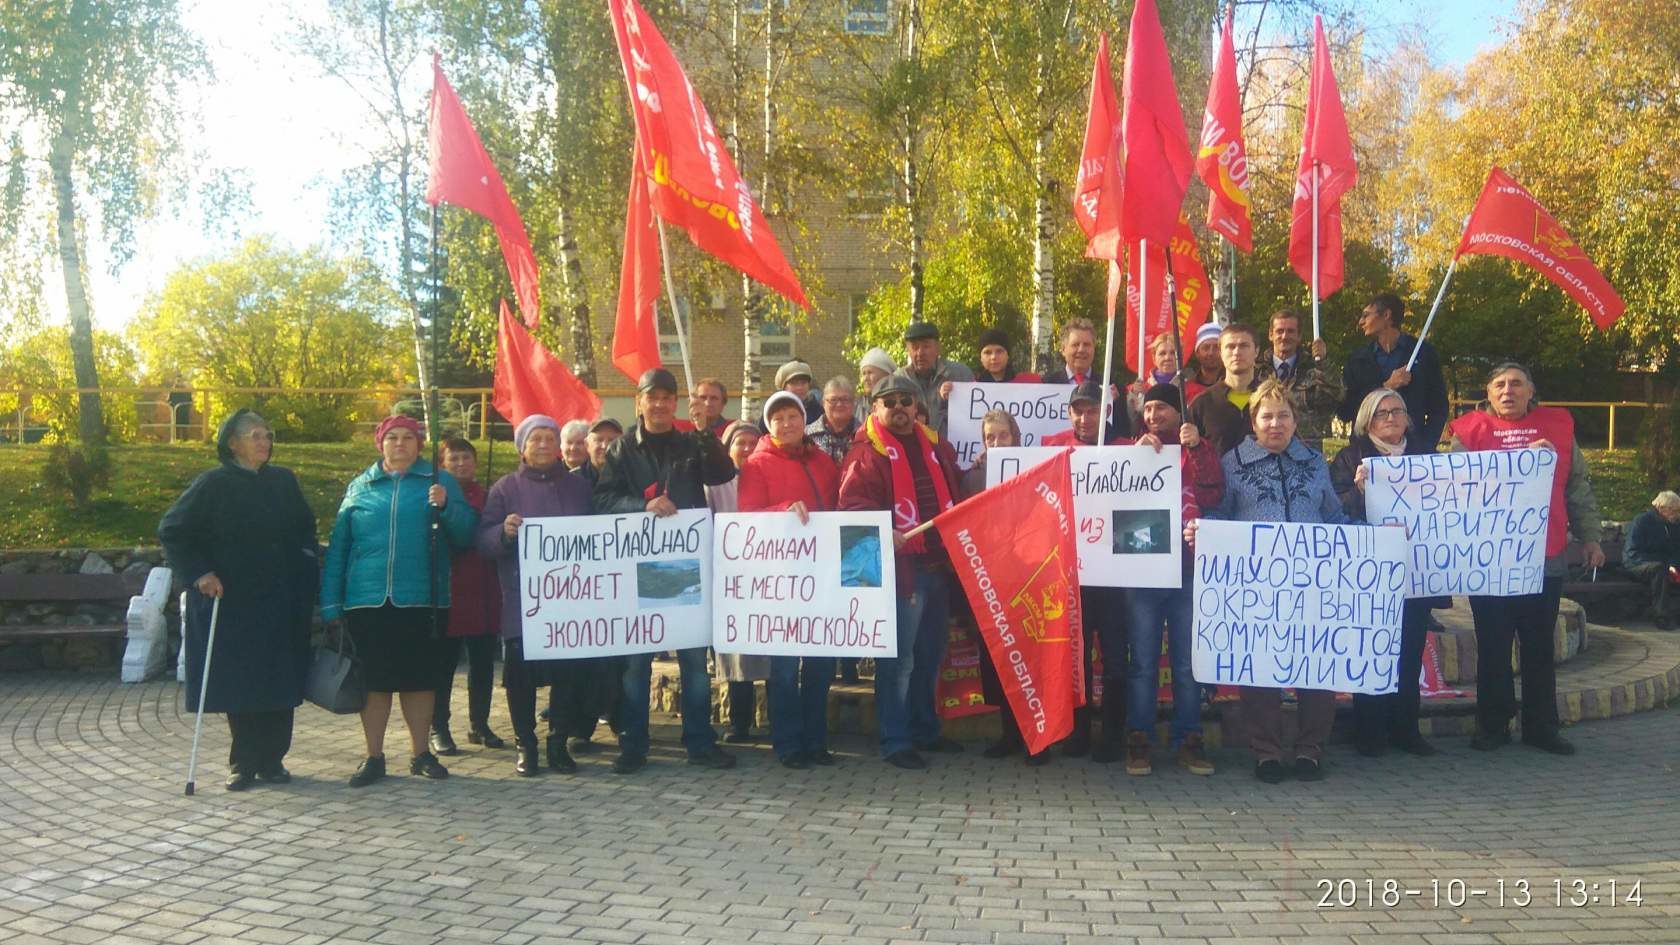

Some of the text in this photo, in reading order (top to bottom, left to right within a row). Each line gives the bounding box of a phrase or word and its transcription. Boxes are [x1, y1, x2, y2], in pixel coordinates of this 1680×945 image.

[1469, 232, 1606, 316] МОСКОВСКАЯ ОБЛАСТЬ
[1369, 449, 1554, 484] ГУБЕРНАТОР
[1391, 481, 1525, 512] ХВАТИТ
[1414, 538, 1536, 571] ПОМОГИ
[1198, 554, 1406, 592] ШАХОВСКОГО
[1411, 565, 1544, 595] НСИОНЕРА
[1199, 587, 1305, 621] ОКРУГА
[956, 528, 1016, 648] МОСКОВСКАЯ
[1008, 649, 1046, 735] ОБЛАСТЬ
[1197, 619, 1401, 657] КОММУНИСТОВ
[1216, 653, 1254, 684] НА
